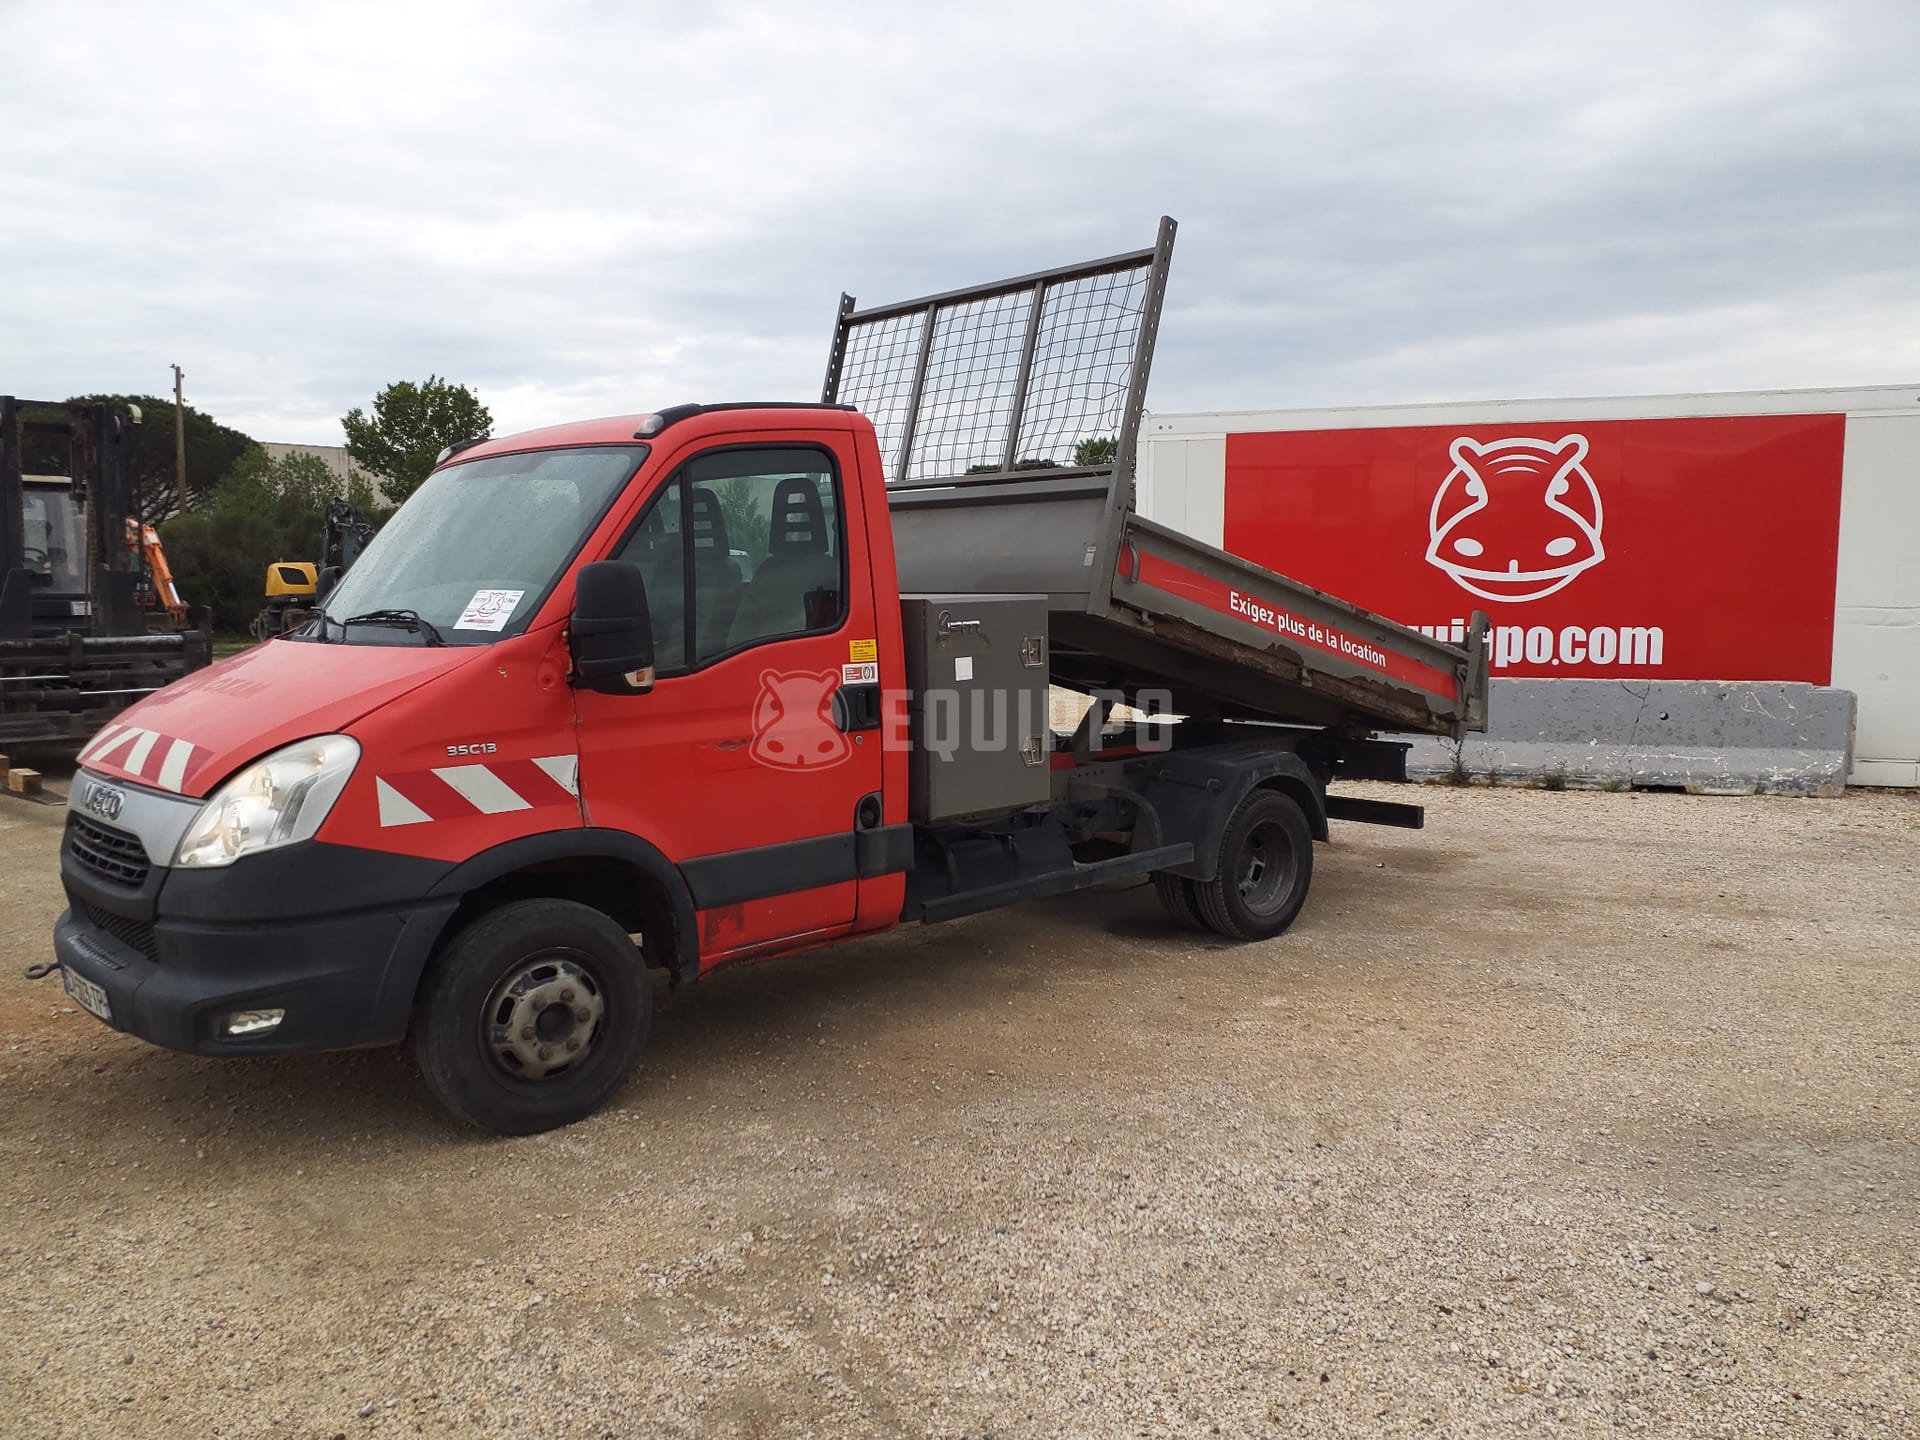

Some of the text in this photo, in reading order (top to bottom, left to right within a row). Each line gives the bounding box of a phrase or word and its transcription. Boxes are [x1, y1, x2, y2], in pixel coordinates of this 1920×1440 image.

[1230, 591, 1387, 667] Exigez plus de la location
[446, 742, 497, 756] 35C13
[83, 781, 125, 820] IVECO
